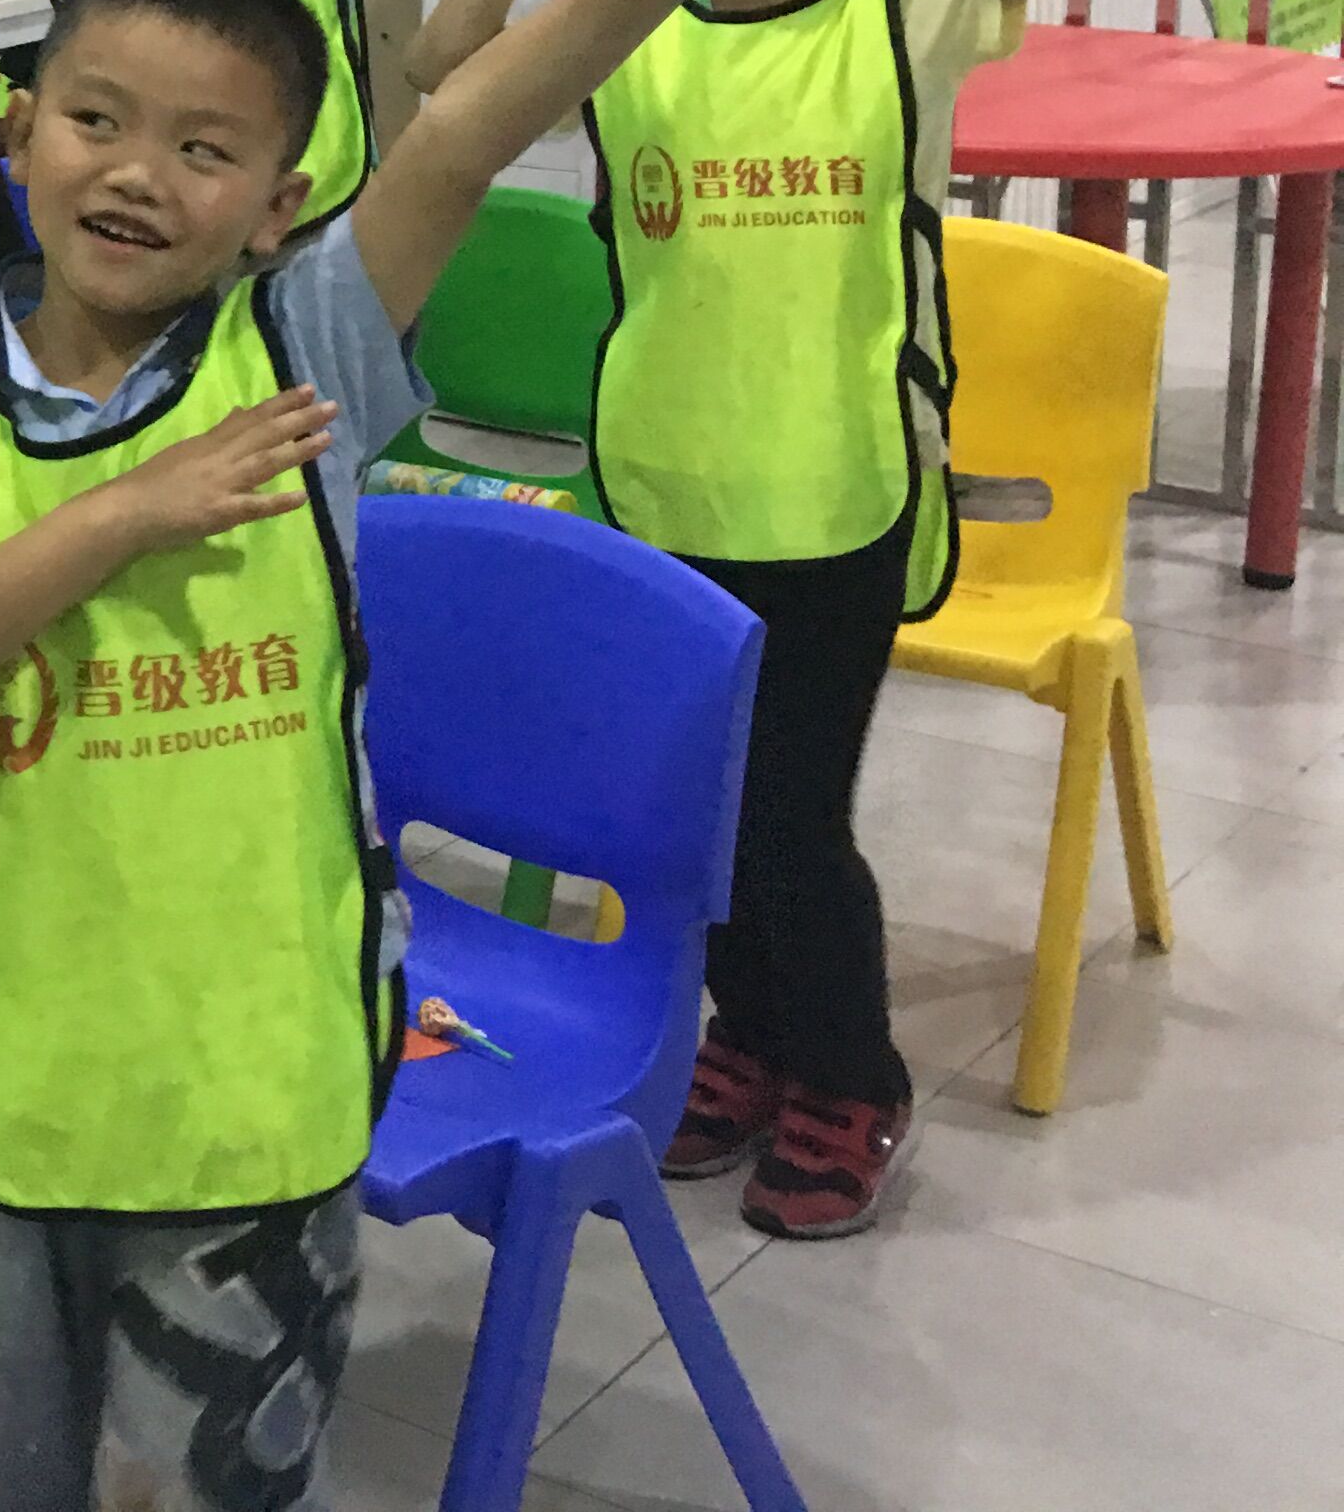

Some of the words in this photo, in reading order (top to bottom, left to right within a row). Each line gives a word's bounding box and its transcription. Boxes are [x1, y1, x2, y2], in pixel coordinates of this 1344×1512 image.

[692, 155, 866, 199] 晋级教育
[697, 213, 726, 228] JIN
[731, 211, 747, 227] JI
[751, 209, 866, 226] EDUCATION
[74, 632, 300, 718] 晋级教育
[76, 739, 122, 761] JIN
[128, 737, 152, 758] JI
[158, 711, 307, 756] EDUCATION
